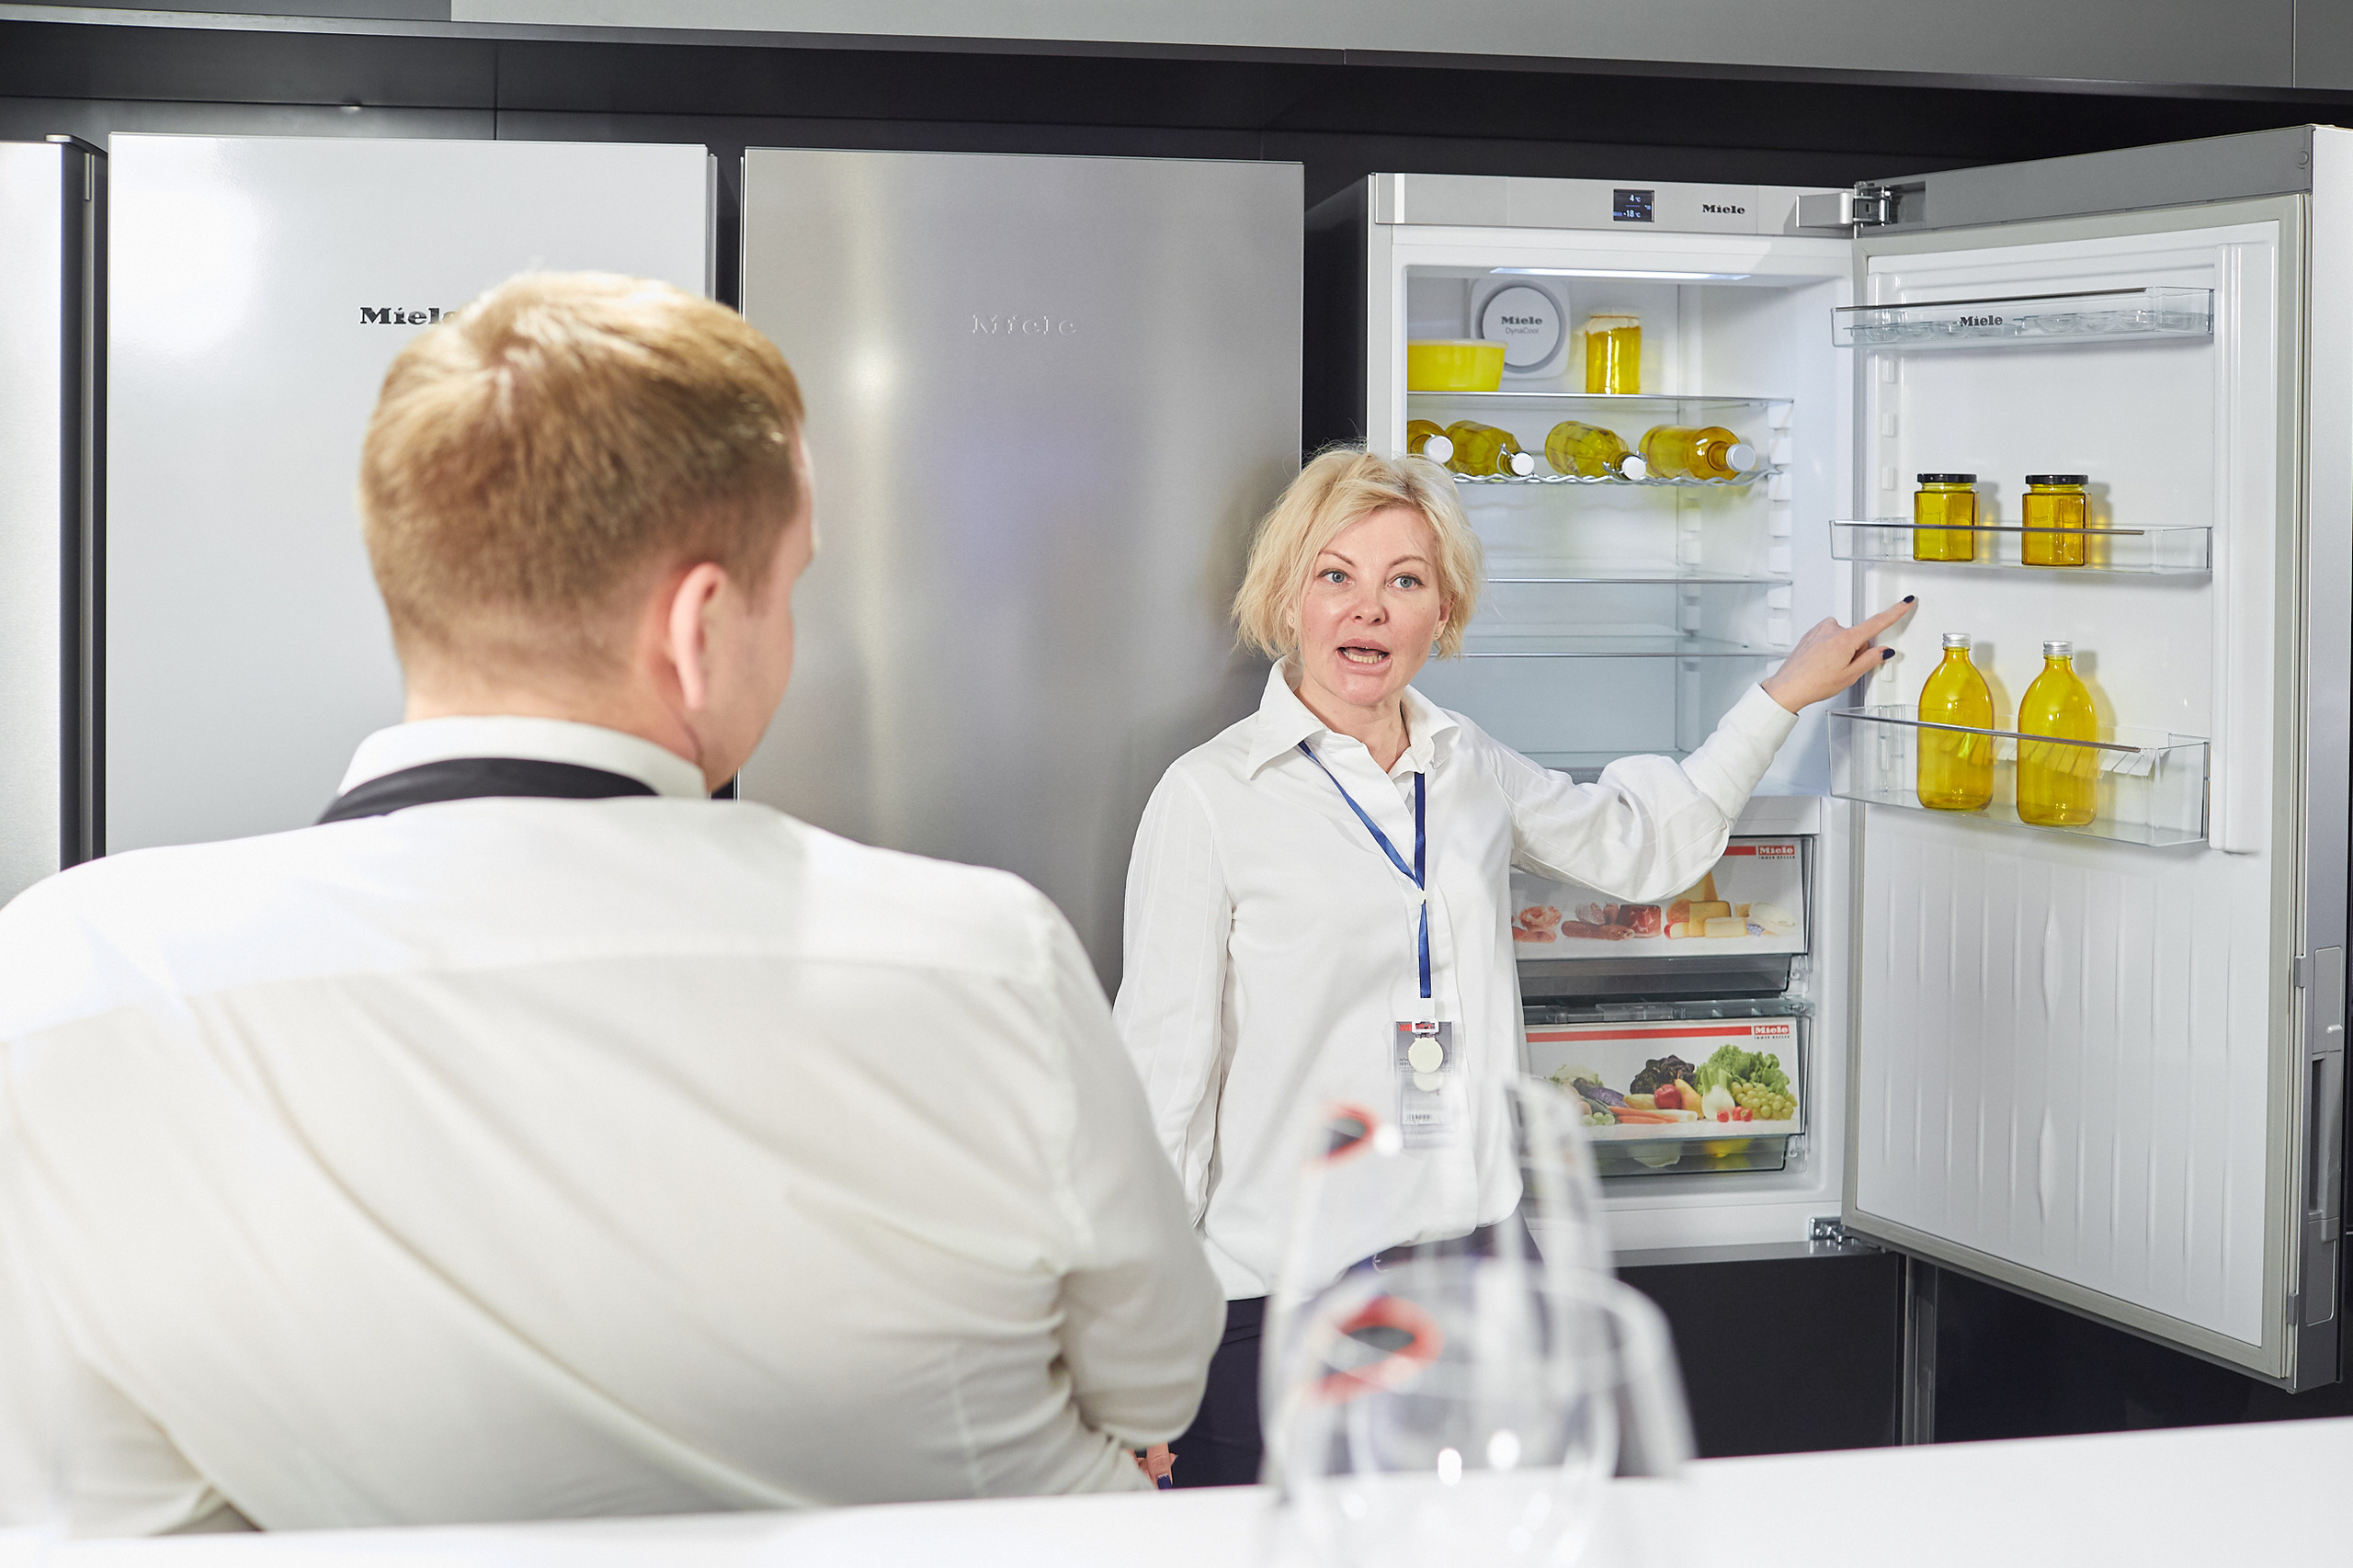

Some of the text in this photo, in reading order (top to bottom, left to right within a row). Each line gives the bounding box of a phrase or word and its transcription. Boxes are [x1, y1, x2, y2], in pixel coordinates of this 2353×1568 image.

[1702, 203, 1745, 214] Miele
[1501, 316, 1543, 324] Miele
[1960, 315, 2003, 327] Miele
[1759, 846, 1794, 855] Miele
[1755, 1026, 1789, 1034] Miele
